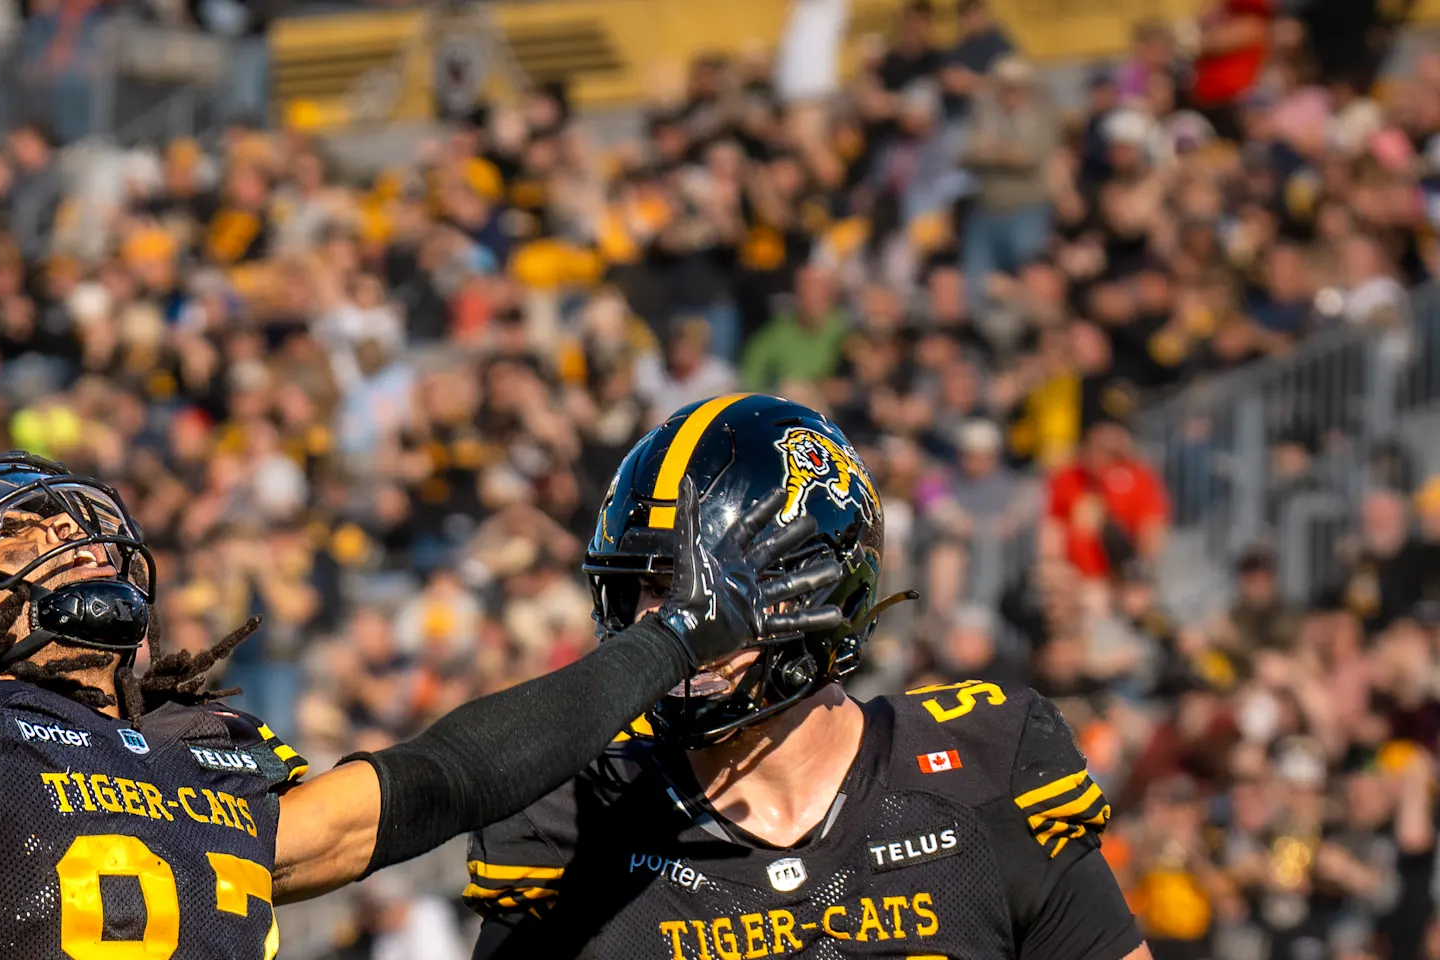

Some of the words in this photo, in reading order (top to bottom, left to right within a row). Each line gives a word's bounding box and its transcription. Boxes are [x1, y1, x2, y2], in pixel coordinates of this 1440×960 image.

[17, 718, 92, 748] porter
[190, 747, 258, 769] TELUS
[40, 771, 258, 838] TIGER-CATS
[870, 828, 958, 867] TELUS
[628, 853, 708, 891] porter
